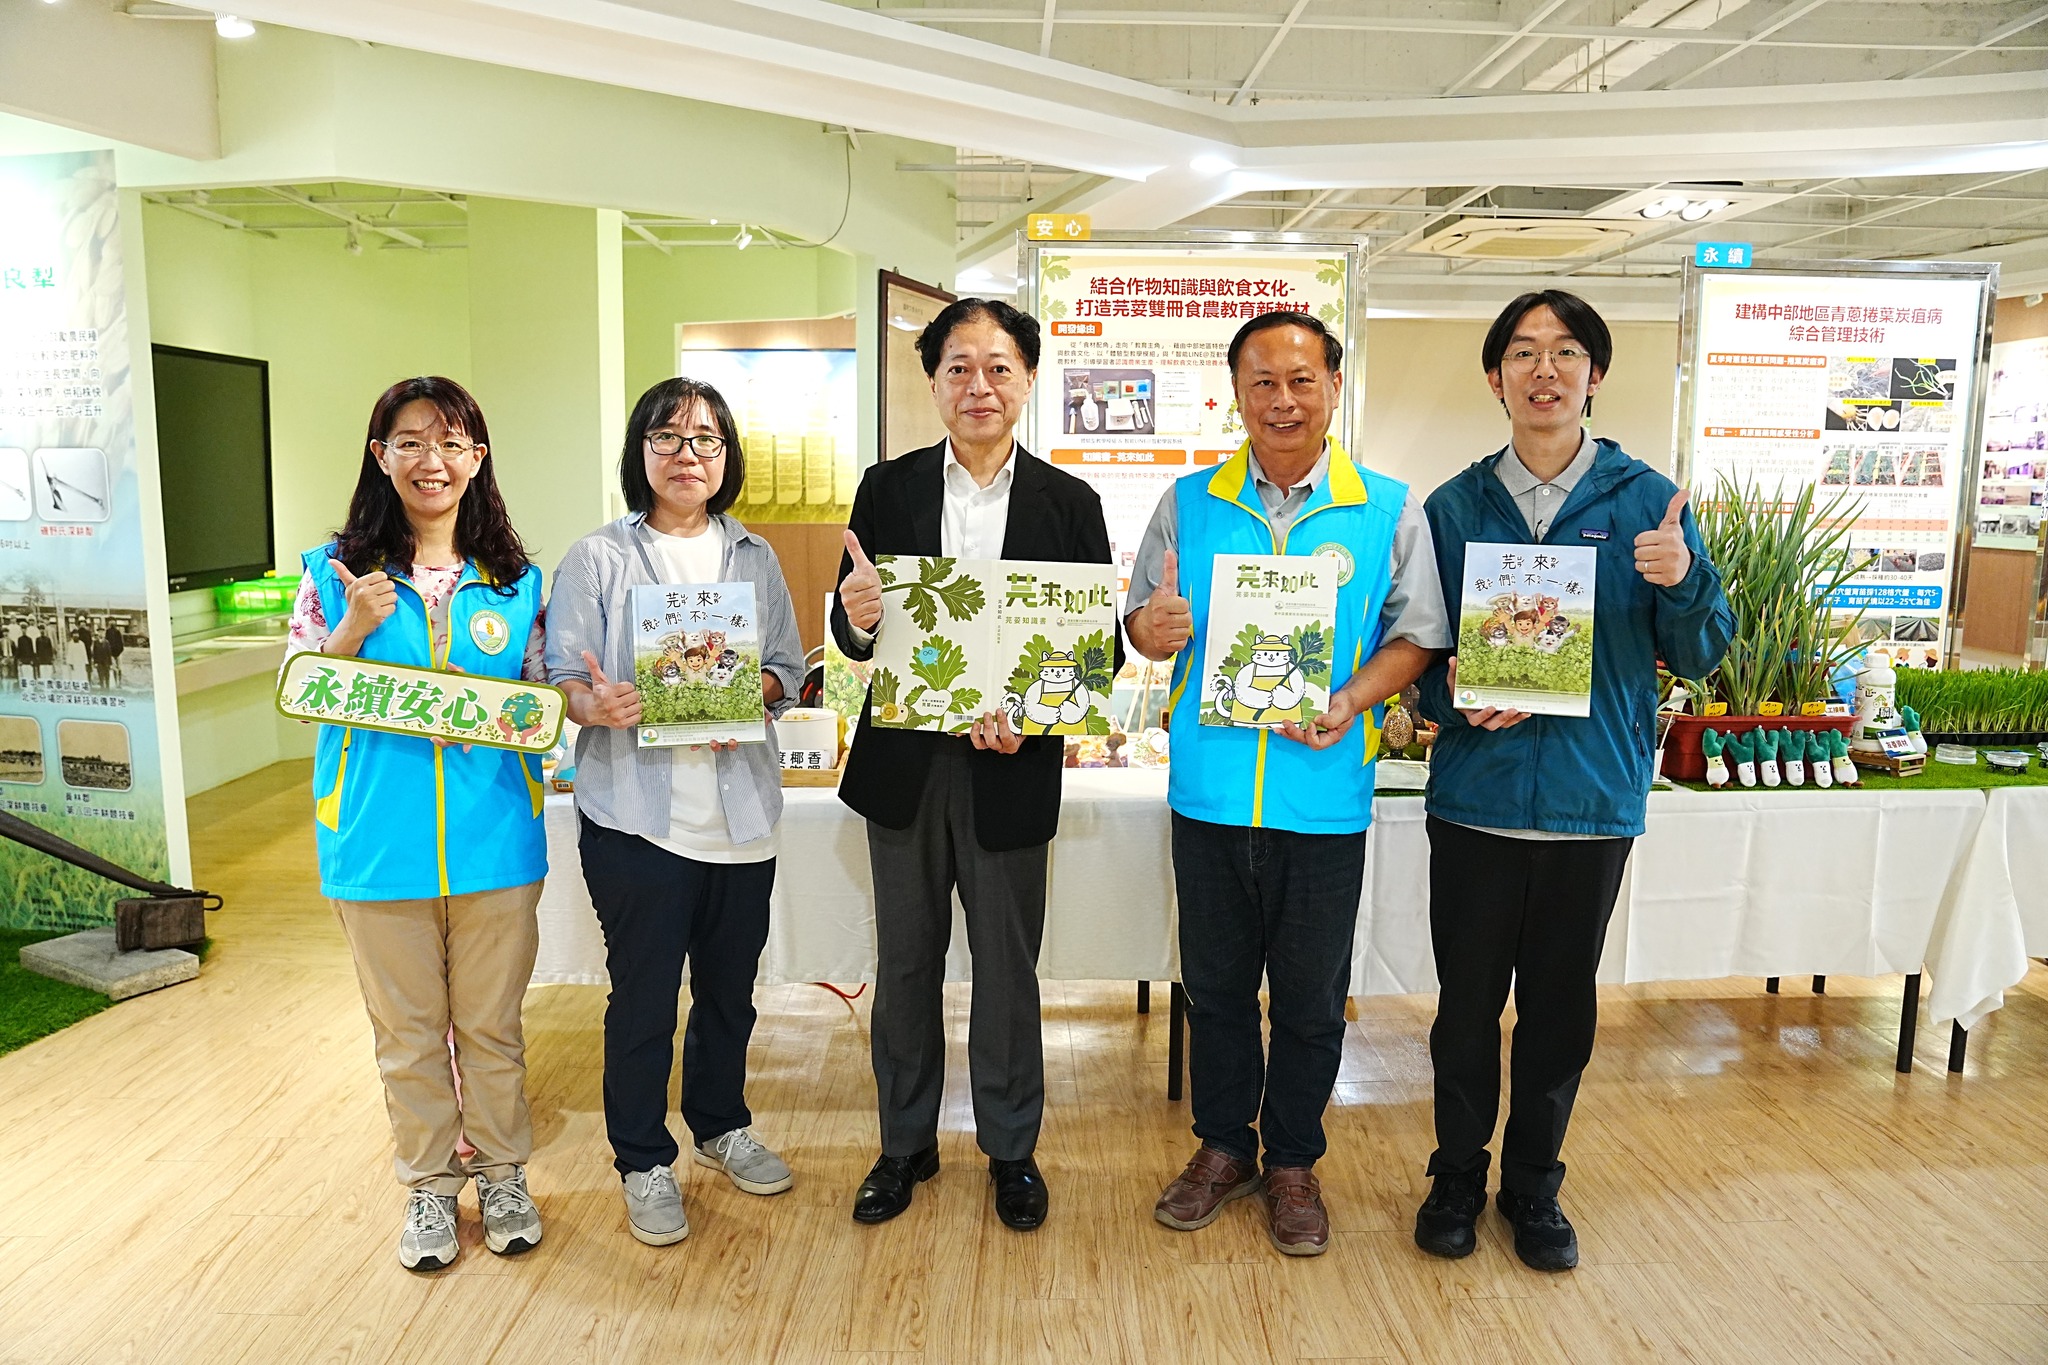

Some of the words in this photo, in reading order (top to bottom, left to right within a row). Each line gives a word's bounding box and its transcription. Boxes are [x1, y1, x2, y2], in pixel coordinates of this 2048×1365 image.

[1036, 219, 1082, 237] 安心
[1703, 247, 1744, 264] 永續
[1090, 277, 1296, 297] 結合作物知識與飲食文化-
[1735, 303, 1943, 325] 建構中部地區青蔥捲葉炭疽病
[1788, 325, 1885, 344] 綜合管理技術
[1236, 564, 1319, 593] 芫來如此
[1006, 573, 1112, 614] 芫來如此
[294, 666, 489, 730] 永續安心
